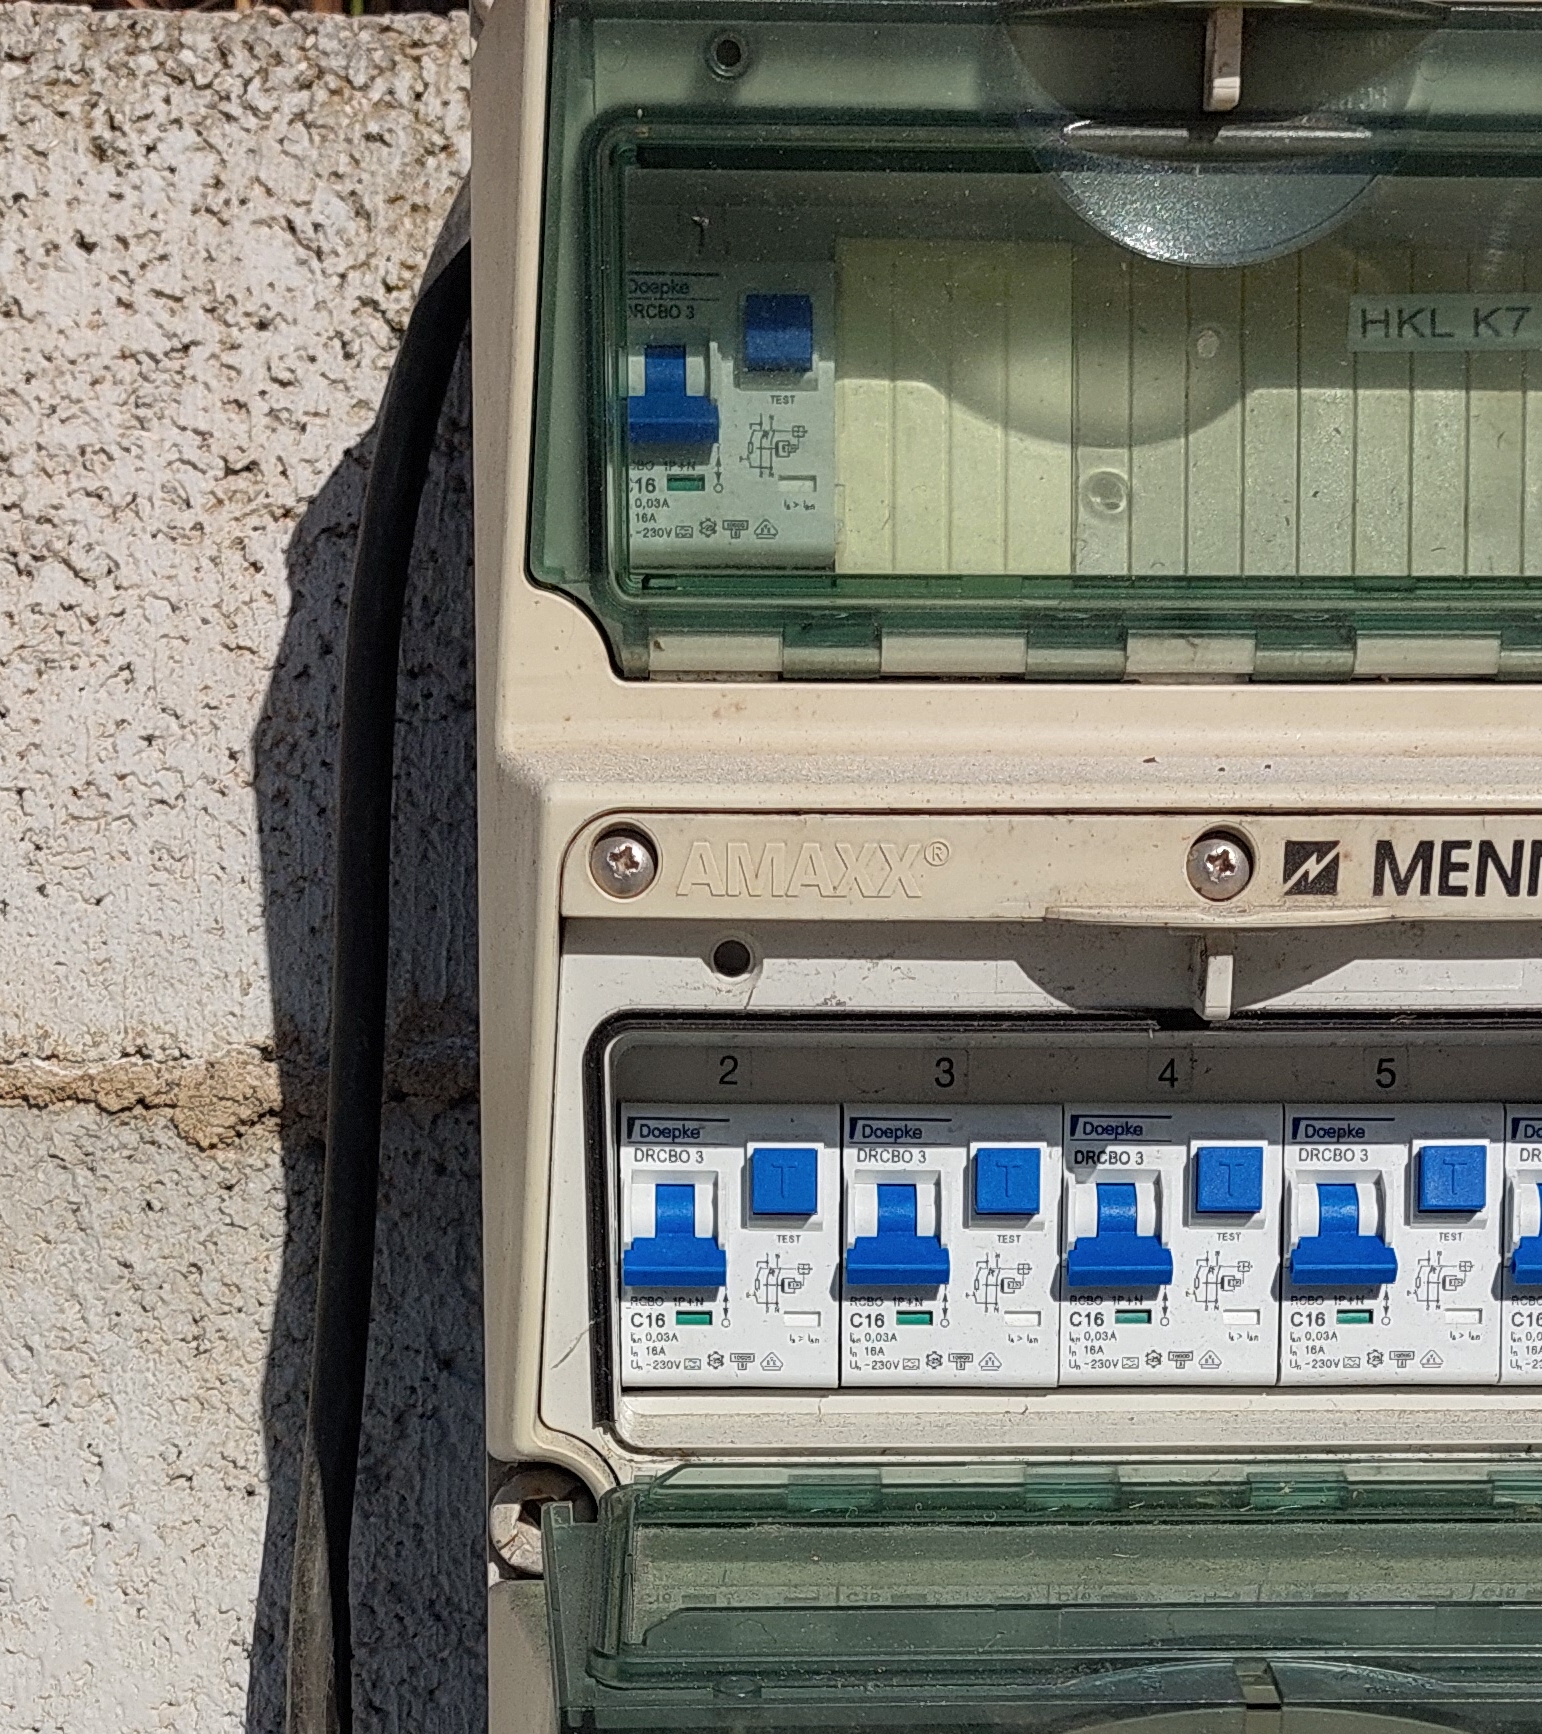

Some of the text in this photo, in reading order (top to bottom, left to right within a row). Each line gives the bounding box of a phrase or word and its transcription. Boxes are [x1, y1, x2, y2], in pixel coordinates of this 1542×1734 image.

[629, 304, 694, 319] RCBO 3
[1361, 307, 1531, 339] HKL K7
[771, 396, 795, 404] TEST
[630, 478, 656, 493] 16
[635, 499, 670, 509] 0,03A
[635, 514, 656, 522] 16A
[719, 1055, 738, 1085] 2
[935, 1057, 954, 1087] 3
[1158, 1059, 1178, 1087] 4
[1376, 1059, 1396, 1088] 5
[640, 1125, 701, 1140] Doepke
[862, 1124, 922, 1142] Doepke
[1083, 1122, 1143, 1139] Doepke
[1305, 1124, 1365, 1141] Doepke
[634, 1148, 704, 1163] DRCBO 3
[857, 1149, 926, 1163] DRCBO 3
[1075, 1150, 1143, 1165] DRCBO 3
[1299, 1149, 1368, 1162] DRCBO 3
[772, 1165, 796, 1199] T
[996, 1161, 1020, 1197] T
[1219, 1161, 1244, 1196] T
[1443, 1159, 1467, 1195] T
[777, 1235, 800, 1243] TEST
[997, 1235, 1021, 1243] TEST
[1217, 1233, 1241, 1241] TEST
[1439, 1232, 1462, 1241] TEST
[631, 1313, 665, 1328] C16
[850, 1313, 884, 1328] C16
[1070, 1312, 1104, 1326] C16
[1291, 1312, 1325, 1326] C16
[646, 1347, 665, 1356] 16A
[865, 1347, 884, 1356] 16A
[1084, 1345, 1104, 1355] 16A
[1306, 1345, 1325, 1354] 16A
